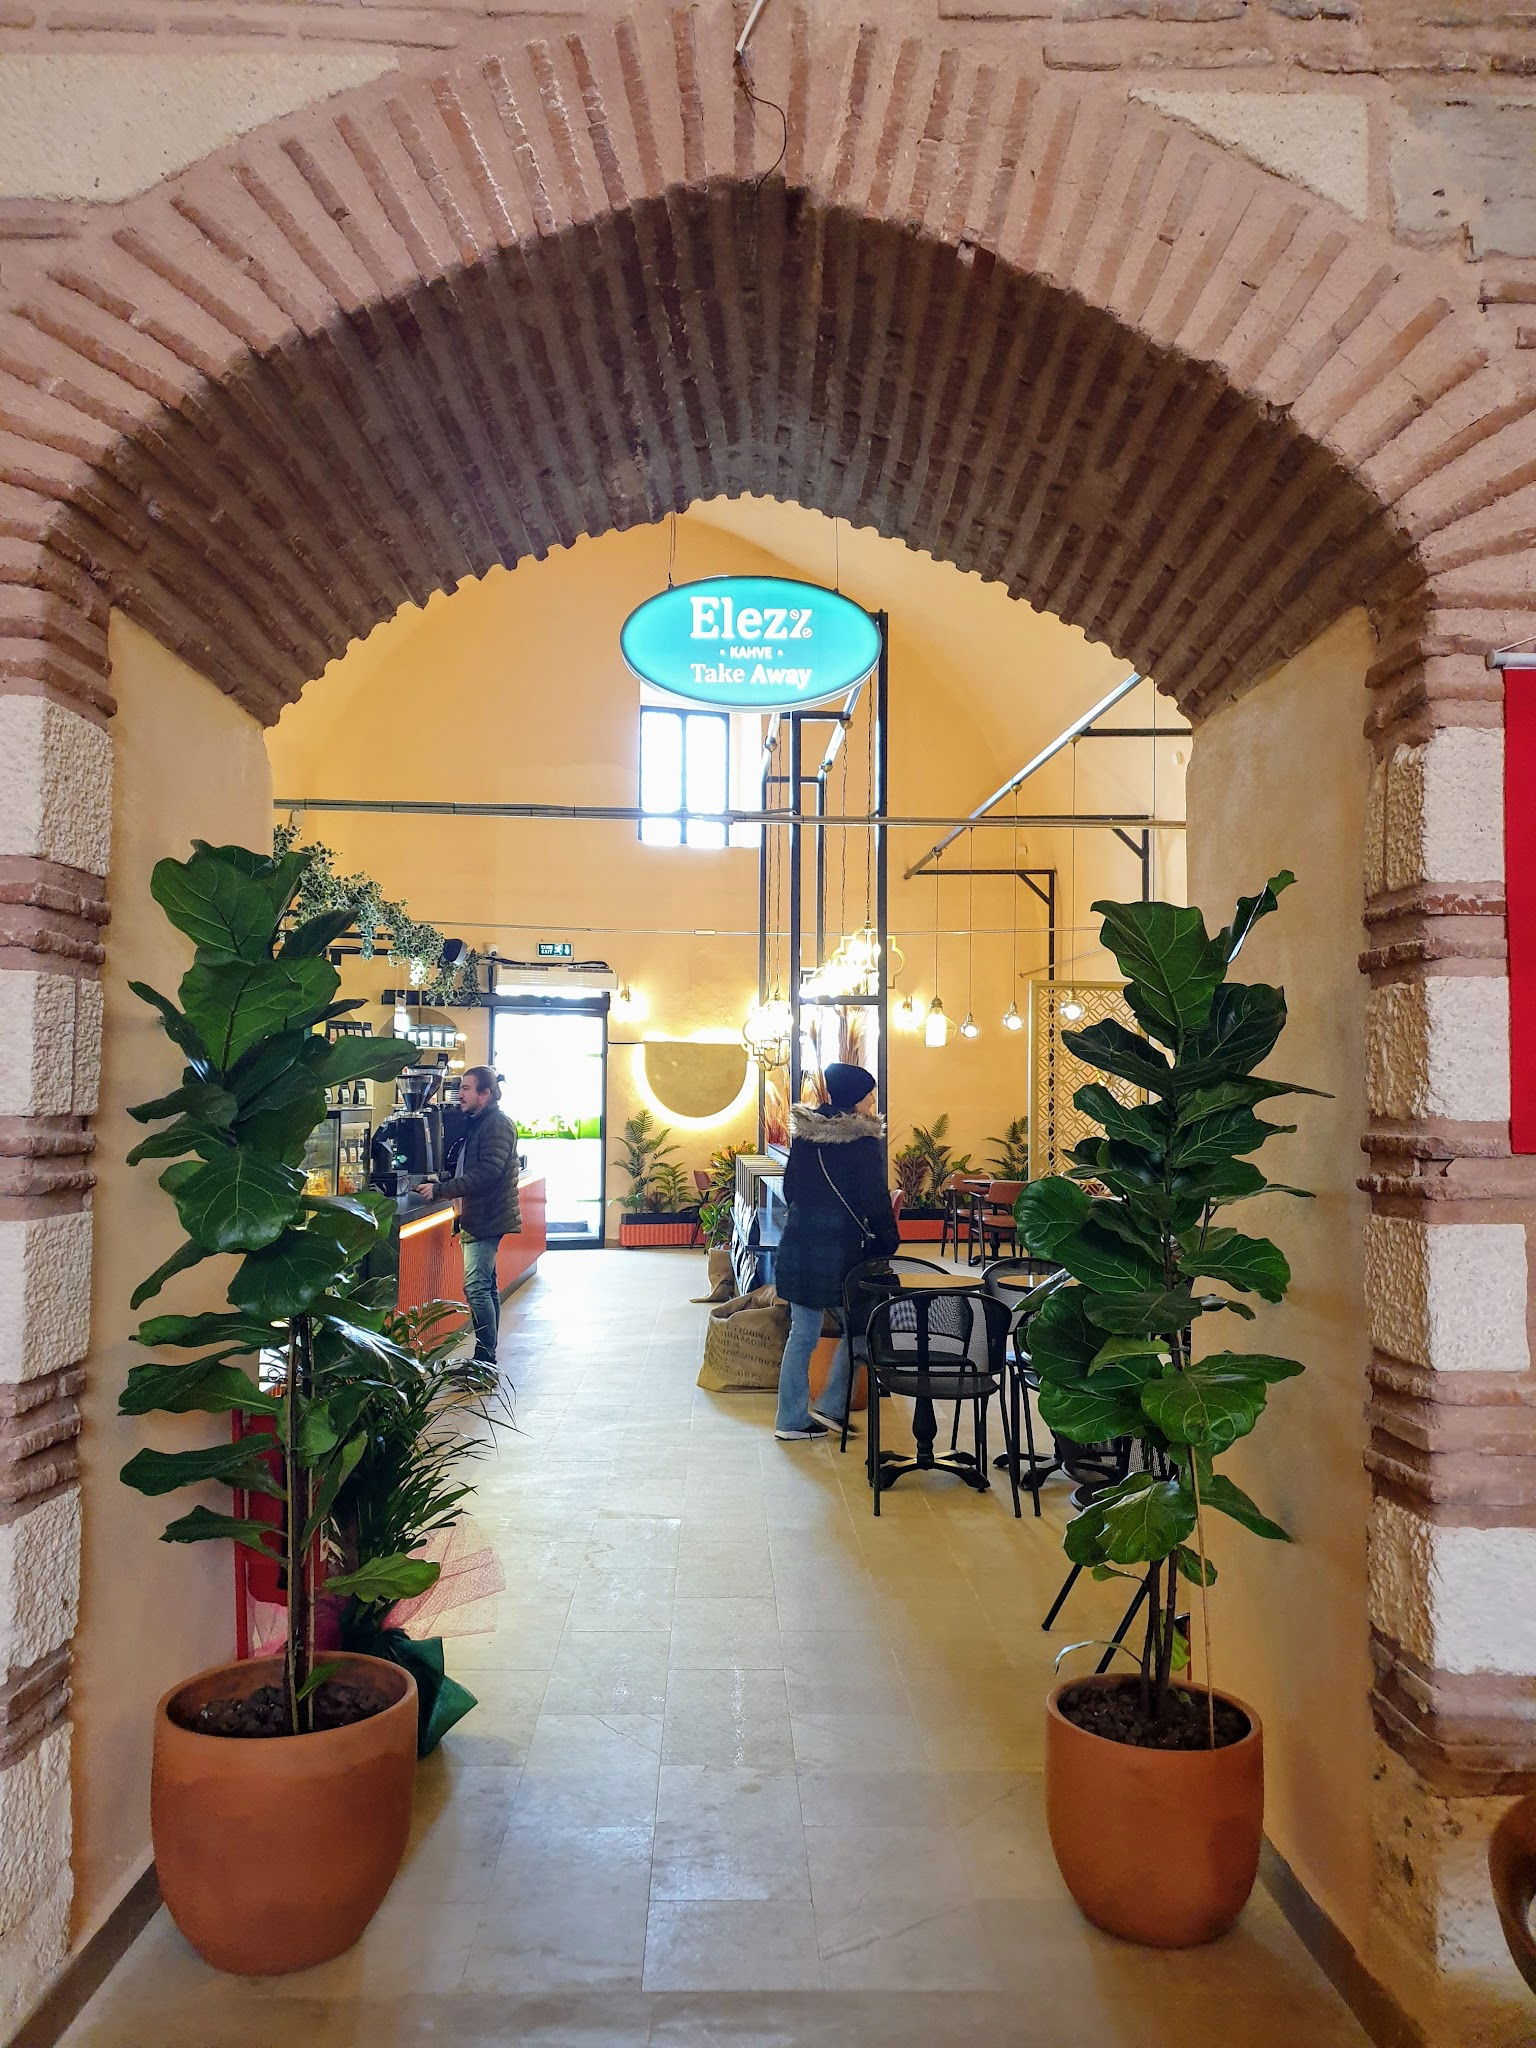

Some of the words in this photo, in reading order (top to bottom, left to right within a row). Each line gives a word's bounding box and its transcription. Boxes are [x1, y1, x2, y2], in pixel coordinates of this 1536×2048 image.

[730, 646, 773, 659] KAHVE
[690, 663, 745, 684] Take
[750, 664, 812, 689] Away
